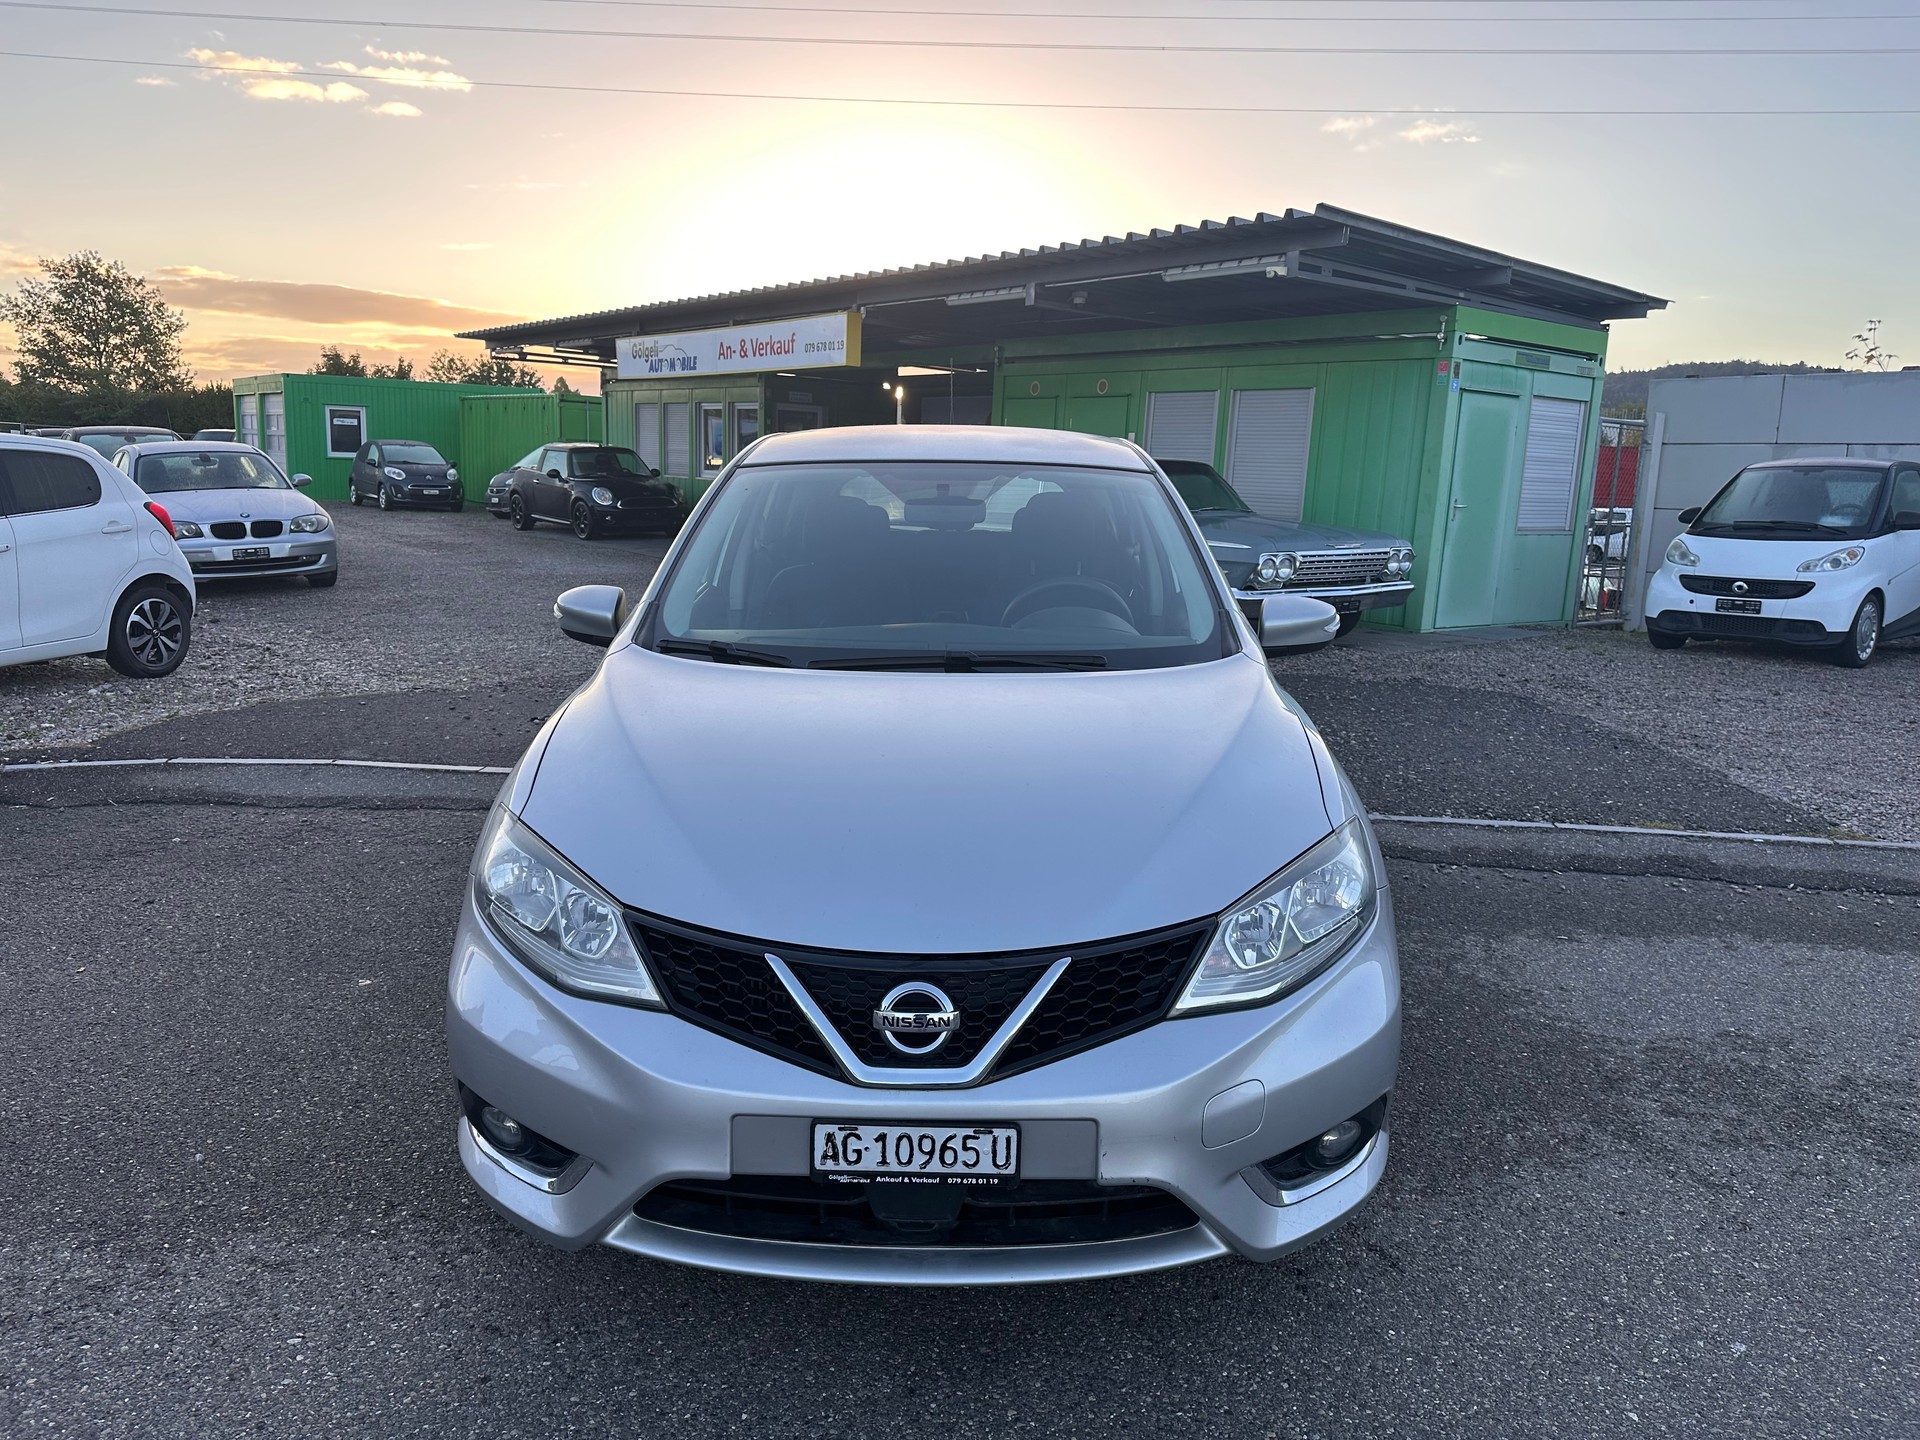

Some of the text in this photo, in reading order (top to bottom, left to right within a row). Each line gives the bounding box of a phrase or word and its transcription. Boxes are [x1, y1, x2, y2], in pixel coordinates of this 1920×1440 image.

[631, 340, 659, 363] Gölgeli
[718, 332, 796, 360] An- & Verkauf
[805, 339, 845, 353] 079 678 01 19
[648, 355, 697, 373] AUTOMOBILE
[882, 1016, 950, 1028] NISSAN
[911, 1176, 940, 1184] Verkauf
